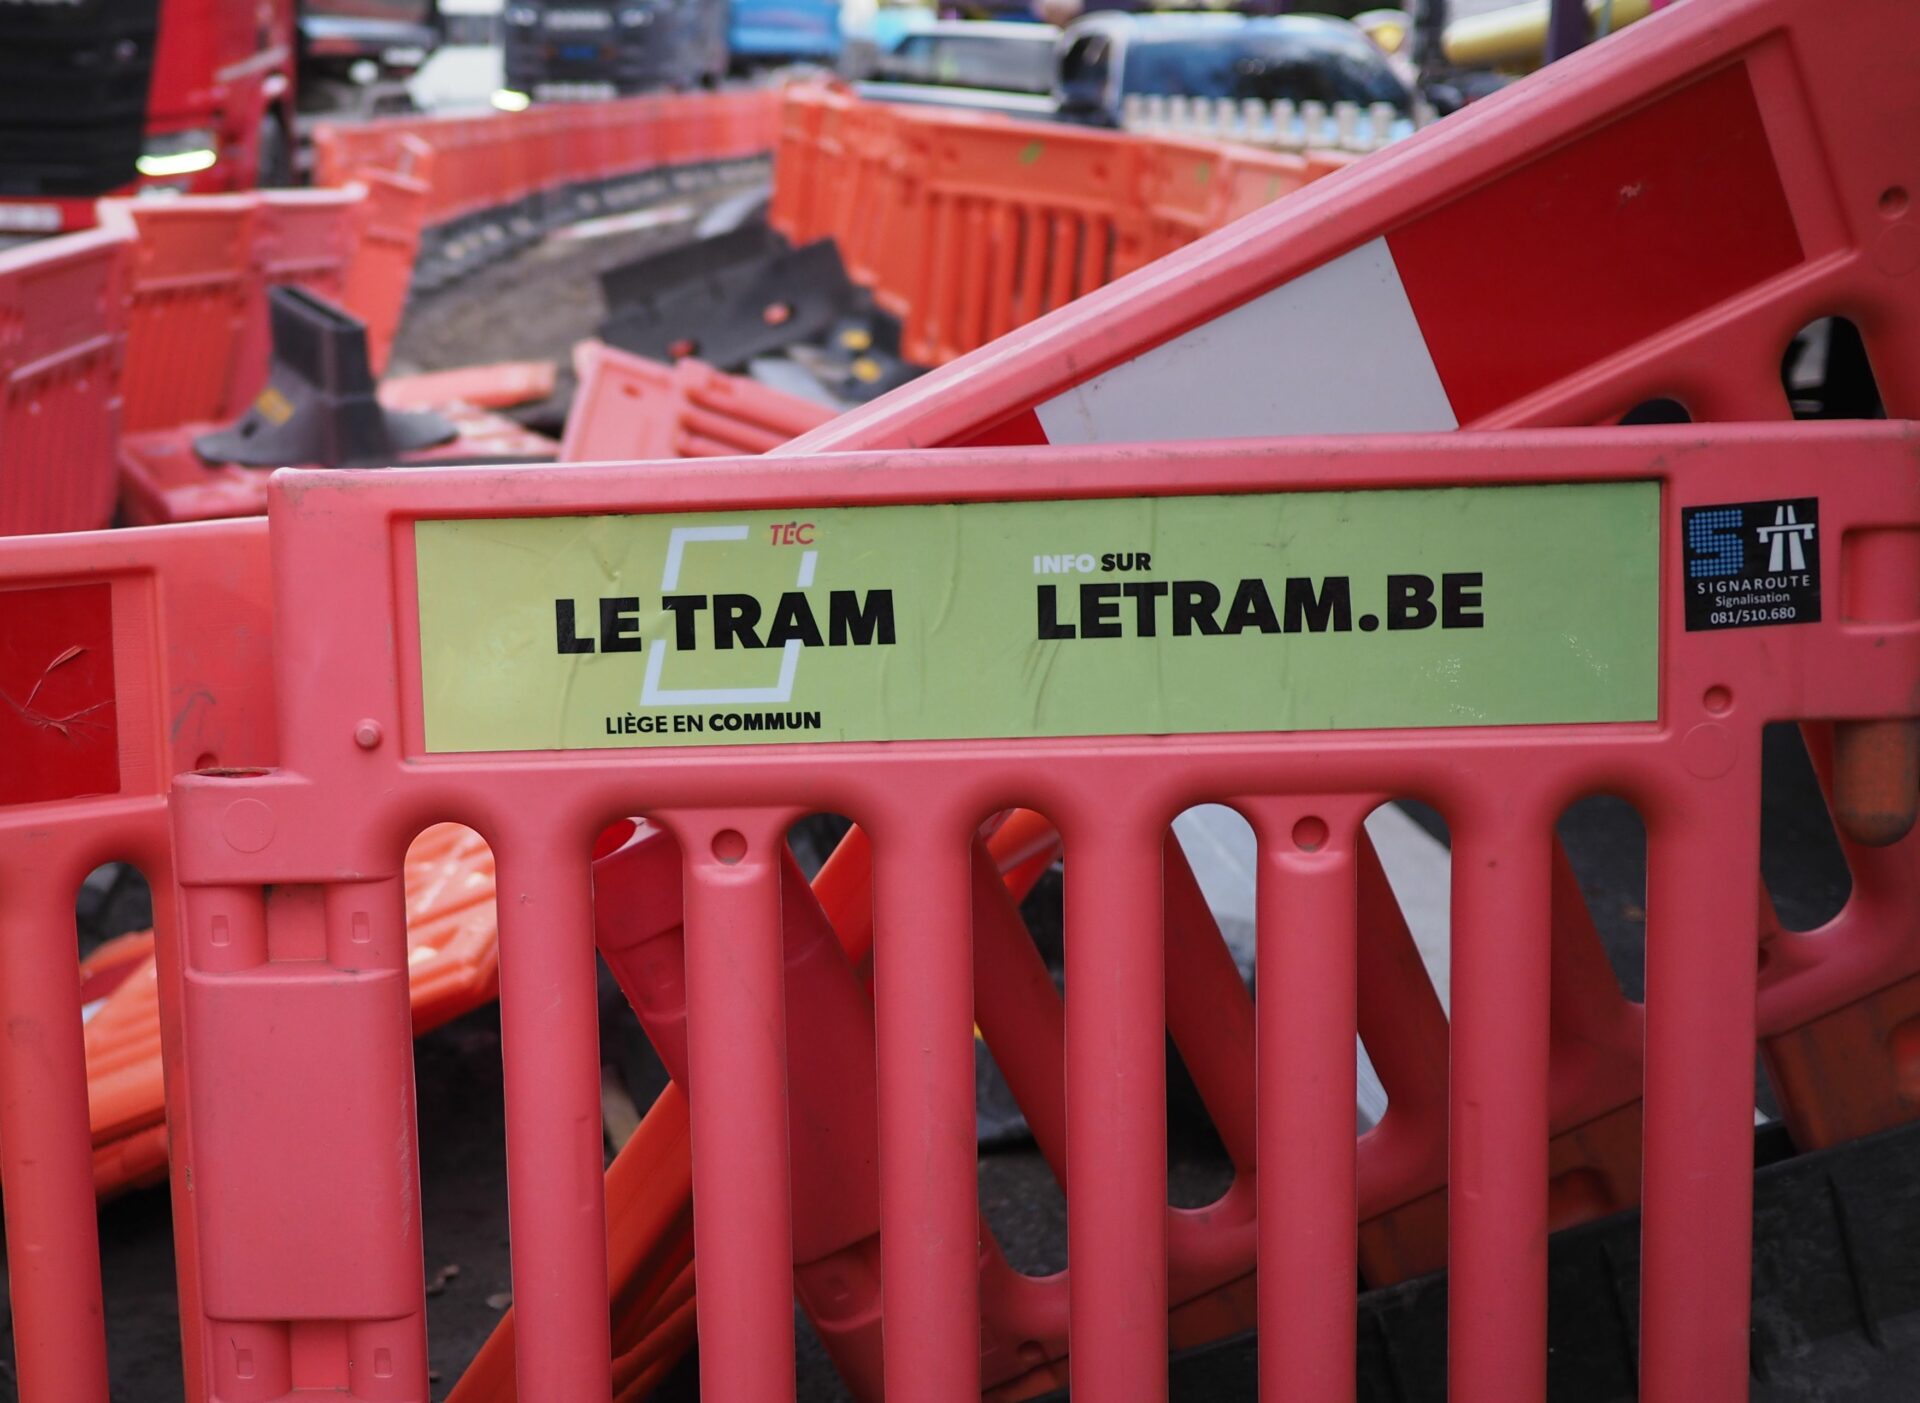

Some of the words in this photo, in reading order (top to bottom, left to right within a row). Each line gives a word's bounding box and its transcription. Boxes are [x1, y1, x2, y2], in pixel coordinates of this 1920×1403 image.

[770, 523, 816, 546] TEC
[1033, 553, 1096, 574] INFO
[1100, 552, 1152, 573] SUR
[1697, 574, 1811, 595] SIGNAROUTE
[1037, 572, 1484, 640] LETRAM.BE
[1715, 592, 1791, 608] Signalisation
[555, 597, 642, 654] LE
[662, 589, 896, 651] TRAM
[1710, 607, 1796, 625] 081/510.680
[606, 712, 668, 735] LIÈGE
[673, 714, 704, 733] EN
[708, 711, 821, 732] COMMUN
